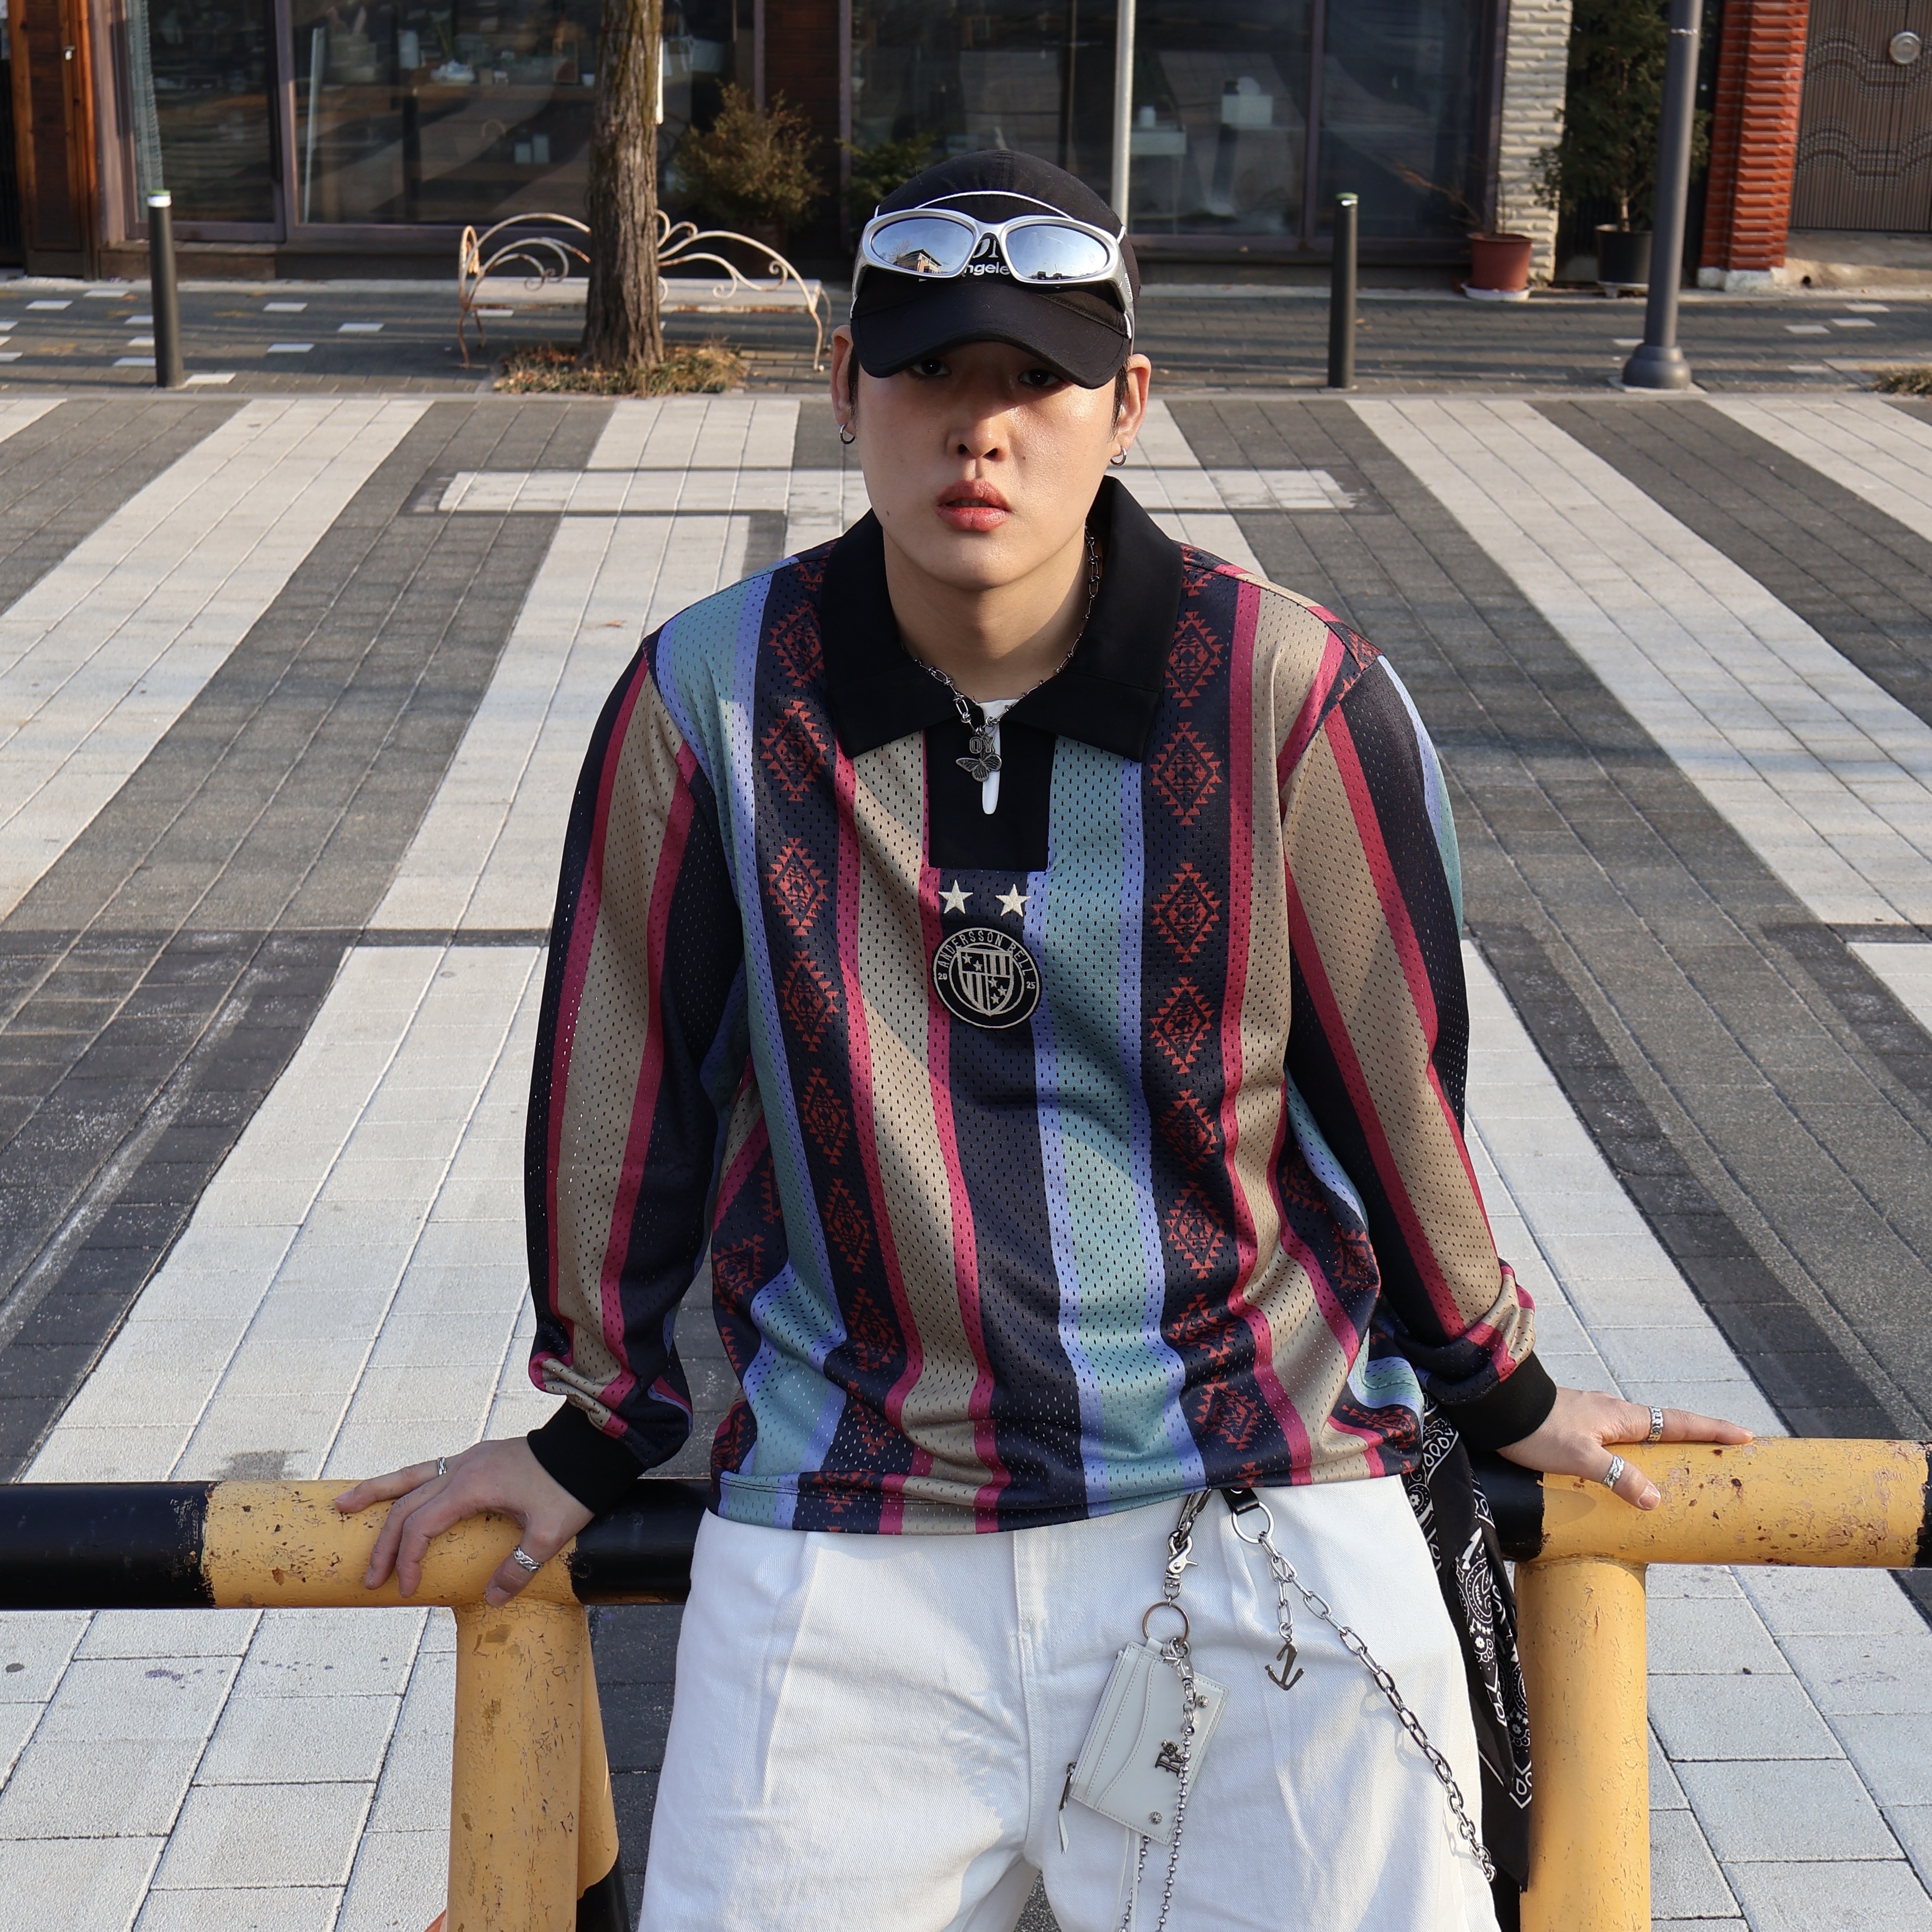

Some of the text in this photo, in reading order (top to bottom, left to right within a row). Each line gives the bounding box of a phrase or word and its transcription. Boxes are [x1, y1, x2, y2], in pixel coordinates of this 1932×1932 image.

[961, 262, 1010, 277] ngele
[938, 930, 1033, 976] ANDERSSON BELL
[938, 972, 1036, 989] 20 25
